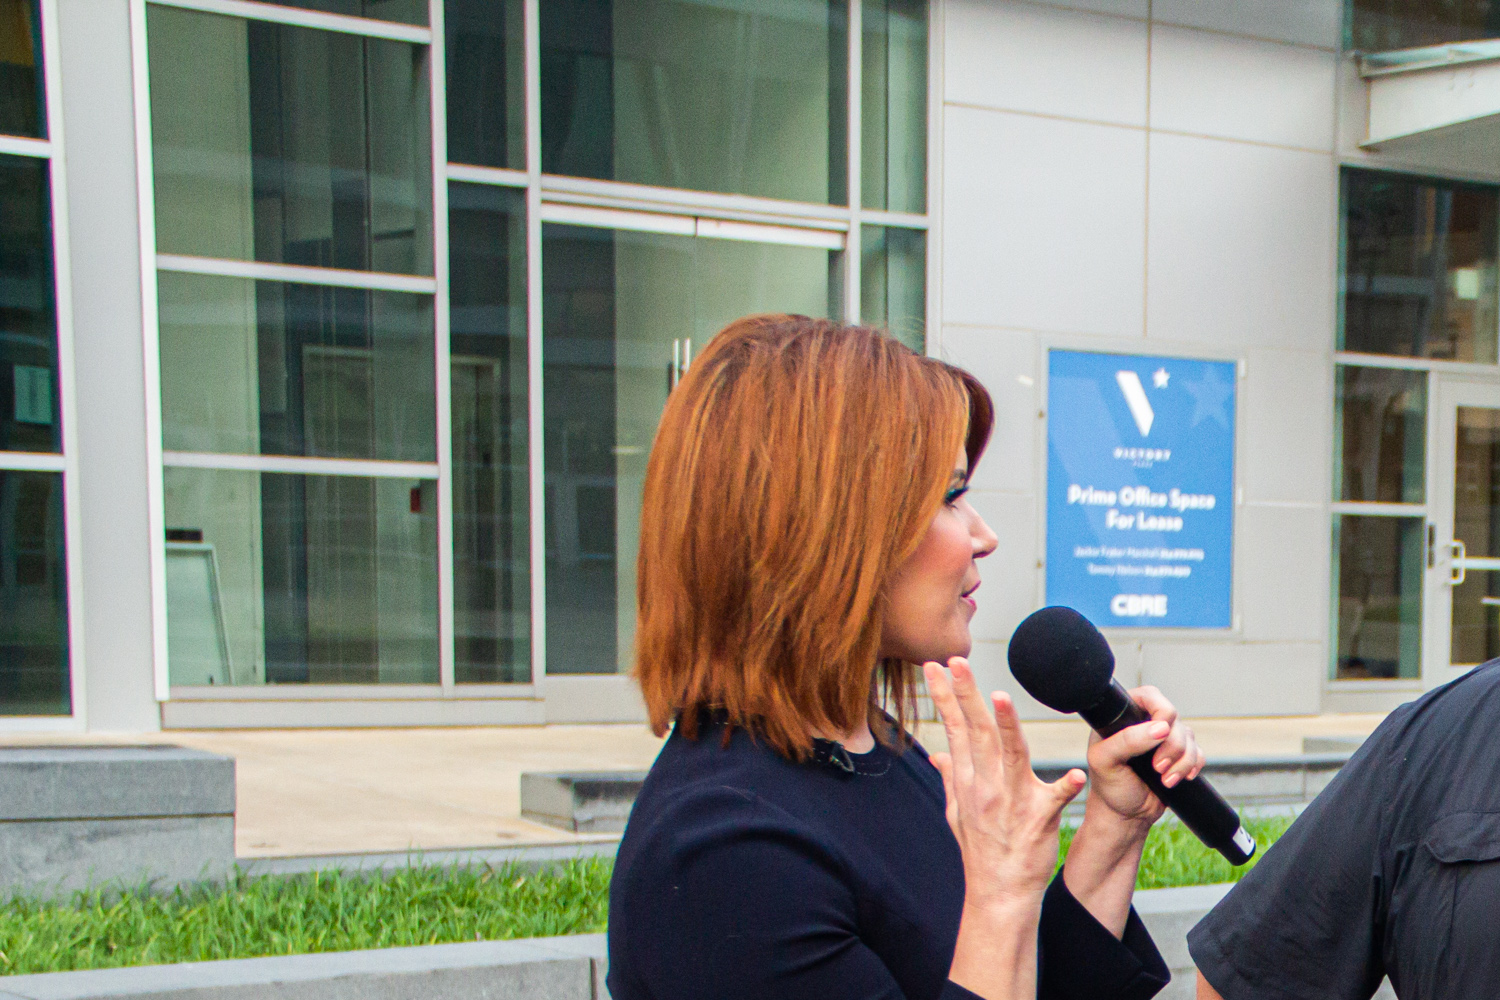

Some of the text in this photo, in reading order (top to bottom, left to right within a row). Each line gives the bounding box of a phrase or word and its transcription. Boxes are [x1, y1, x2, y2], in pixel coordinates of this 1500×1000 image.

[1067, 484, 1216, 513] Prime Office Space
[1105, 508, 1183, 532] For Lease
[1111, 594, 1168, 617] CBRE
